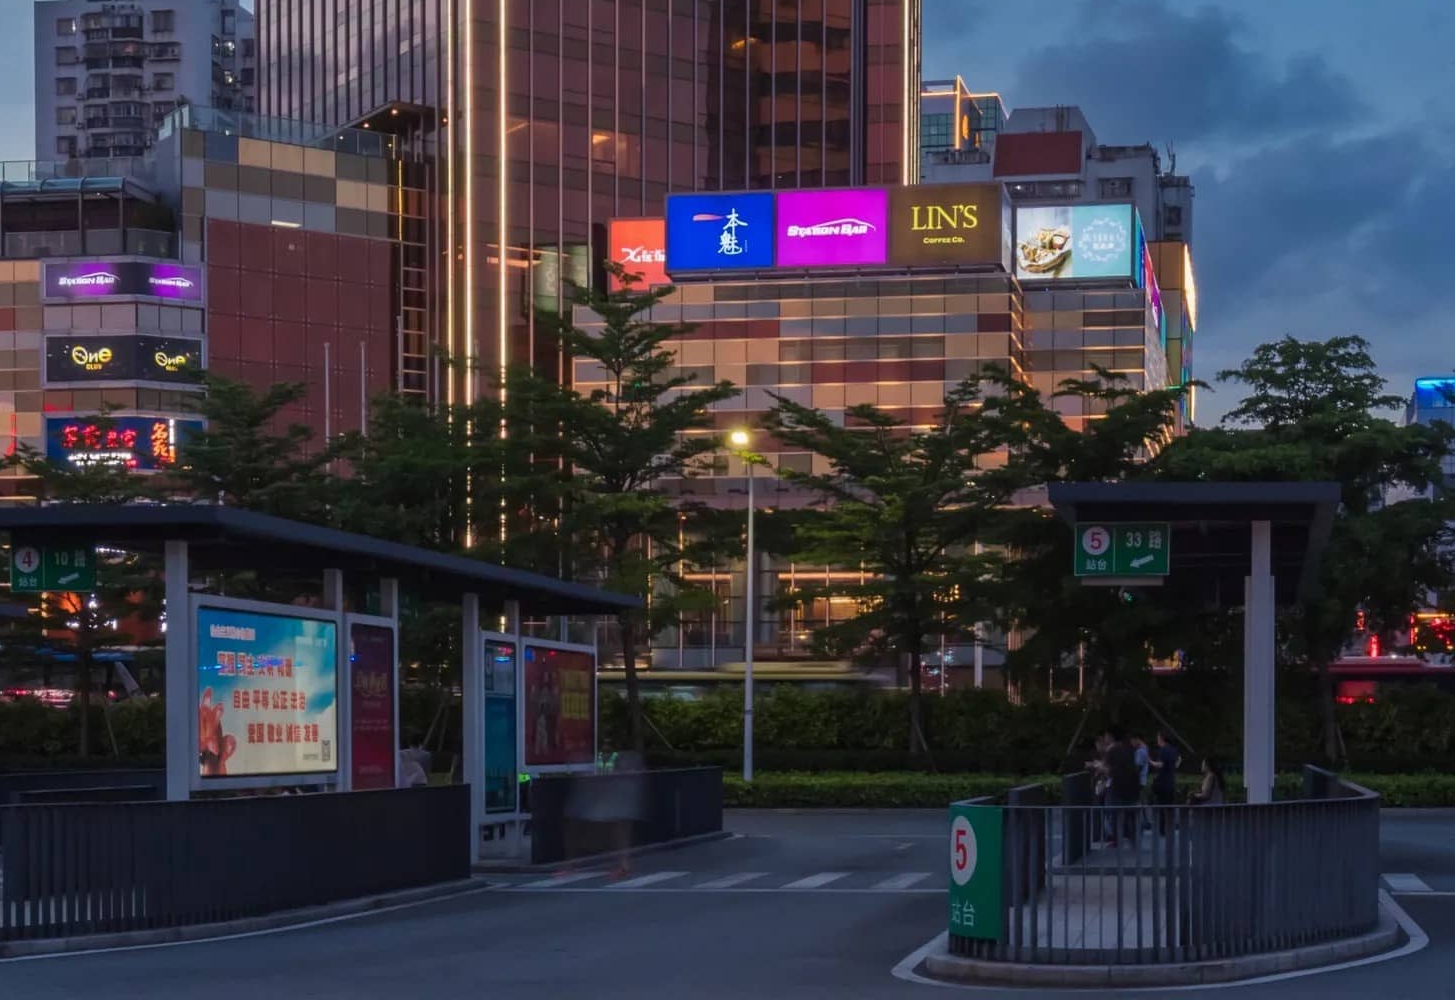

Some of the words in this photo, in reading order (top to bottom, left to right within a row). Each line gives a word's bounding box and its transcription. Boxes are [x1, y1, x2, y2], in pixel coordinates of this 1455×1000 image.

[911, 205, 978, 231] LIN'S
[1090, 531, 1102, 550] 5
[1125, 532, 1143, 548] 33
[1149, 530, 1162, 549] 路
[22, 552, 34, 568] 4
[54, 552, 69, 566] 10
[1085, 558, 1107, 571] 站台
[233, 690, 249, 709] 自由
[253, 690, 269, 710] 平等
[272, 690, 288, 710] 公正
[955, 829, 967, 871] 5
